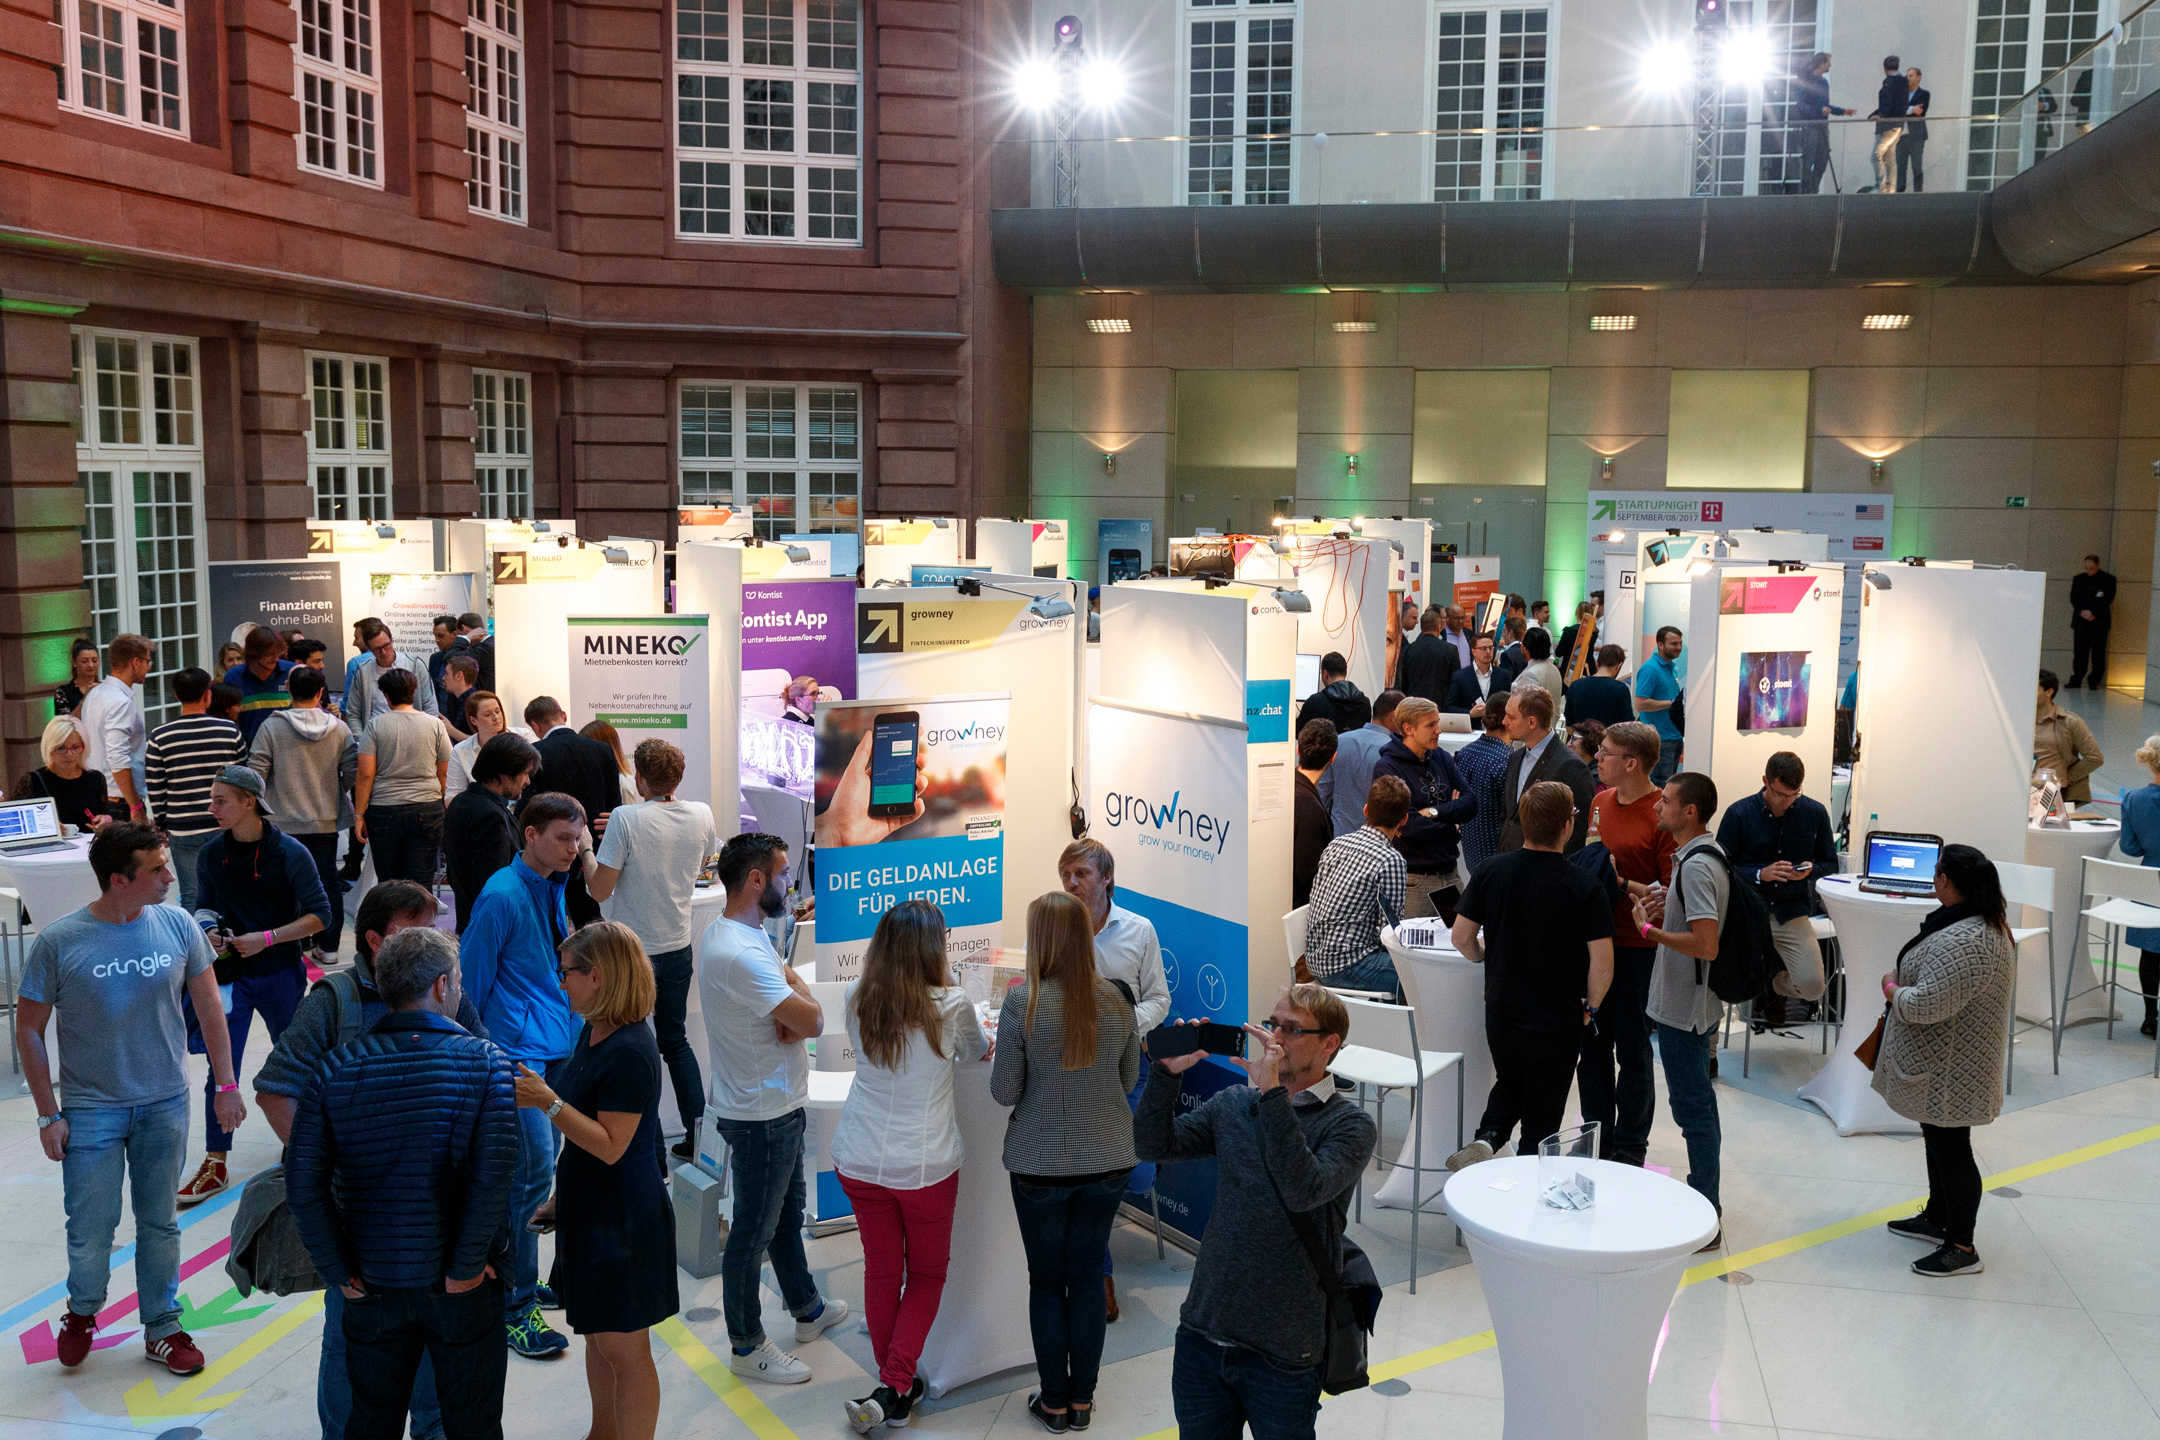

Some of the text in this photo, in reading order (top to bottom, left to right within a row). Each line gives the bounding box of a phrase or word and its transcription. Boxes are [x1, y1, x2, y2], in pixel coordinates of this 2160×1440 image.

[1617, 500, 1699, 511] STARTUPNIGHT
[1617, 513, 1699, 522] SEPTEMBER/08/2017
[1749, 581, 1768, 589] STOMT
[757, 590, 783, 600] Kontist
[1823, 589, 1841, 598] stomt
[259, 599, 333, 612] Finanzieren
[392, 602, 448, 611] Crowdinvesting:
[270, 612, 334, 626] ohne Bank!
[794, 609, 829, 630] App
[910, 609, 954, 621] growney
[394, 620, 414, 628] große
[747, 635, 765, 644] unter
[765, 633, 827, 643] kontist.com/ios-app
[583, 635, 688, 656] MINEKO
[584, 657, 689, 667] Mietnebenkosten korrekt?
[1773, 678, 1793, 689] stomt
[612, 692, 667, 703] Wir prüfen Ihre
[588, 701, 693, 712] Nebenkostenabrechnung auf
[609, 716, 672, 726] www.mineko.de
[927, 720, 1005, 747] growney
[949, 742, 965, 751] grow
[965, 742, 978, 750] your
[1105, 789, 1231, 855] growney
[1138, 832, 1216, 865] grow your money
[828, 857, 999, 893] DIE GELDANLAGE
[858, 892, 894, 916] FÜR
[92, 951, 172, 978] cringle
[837, 952, 859, 967] Wir
